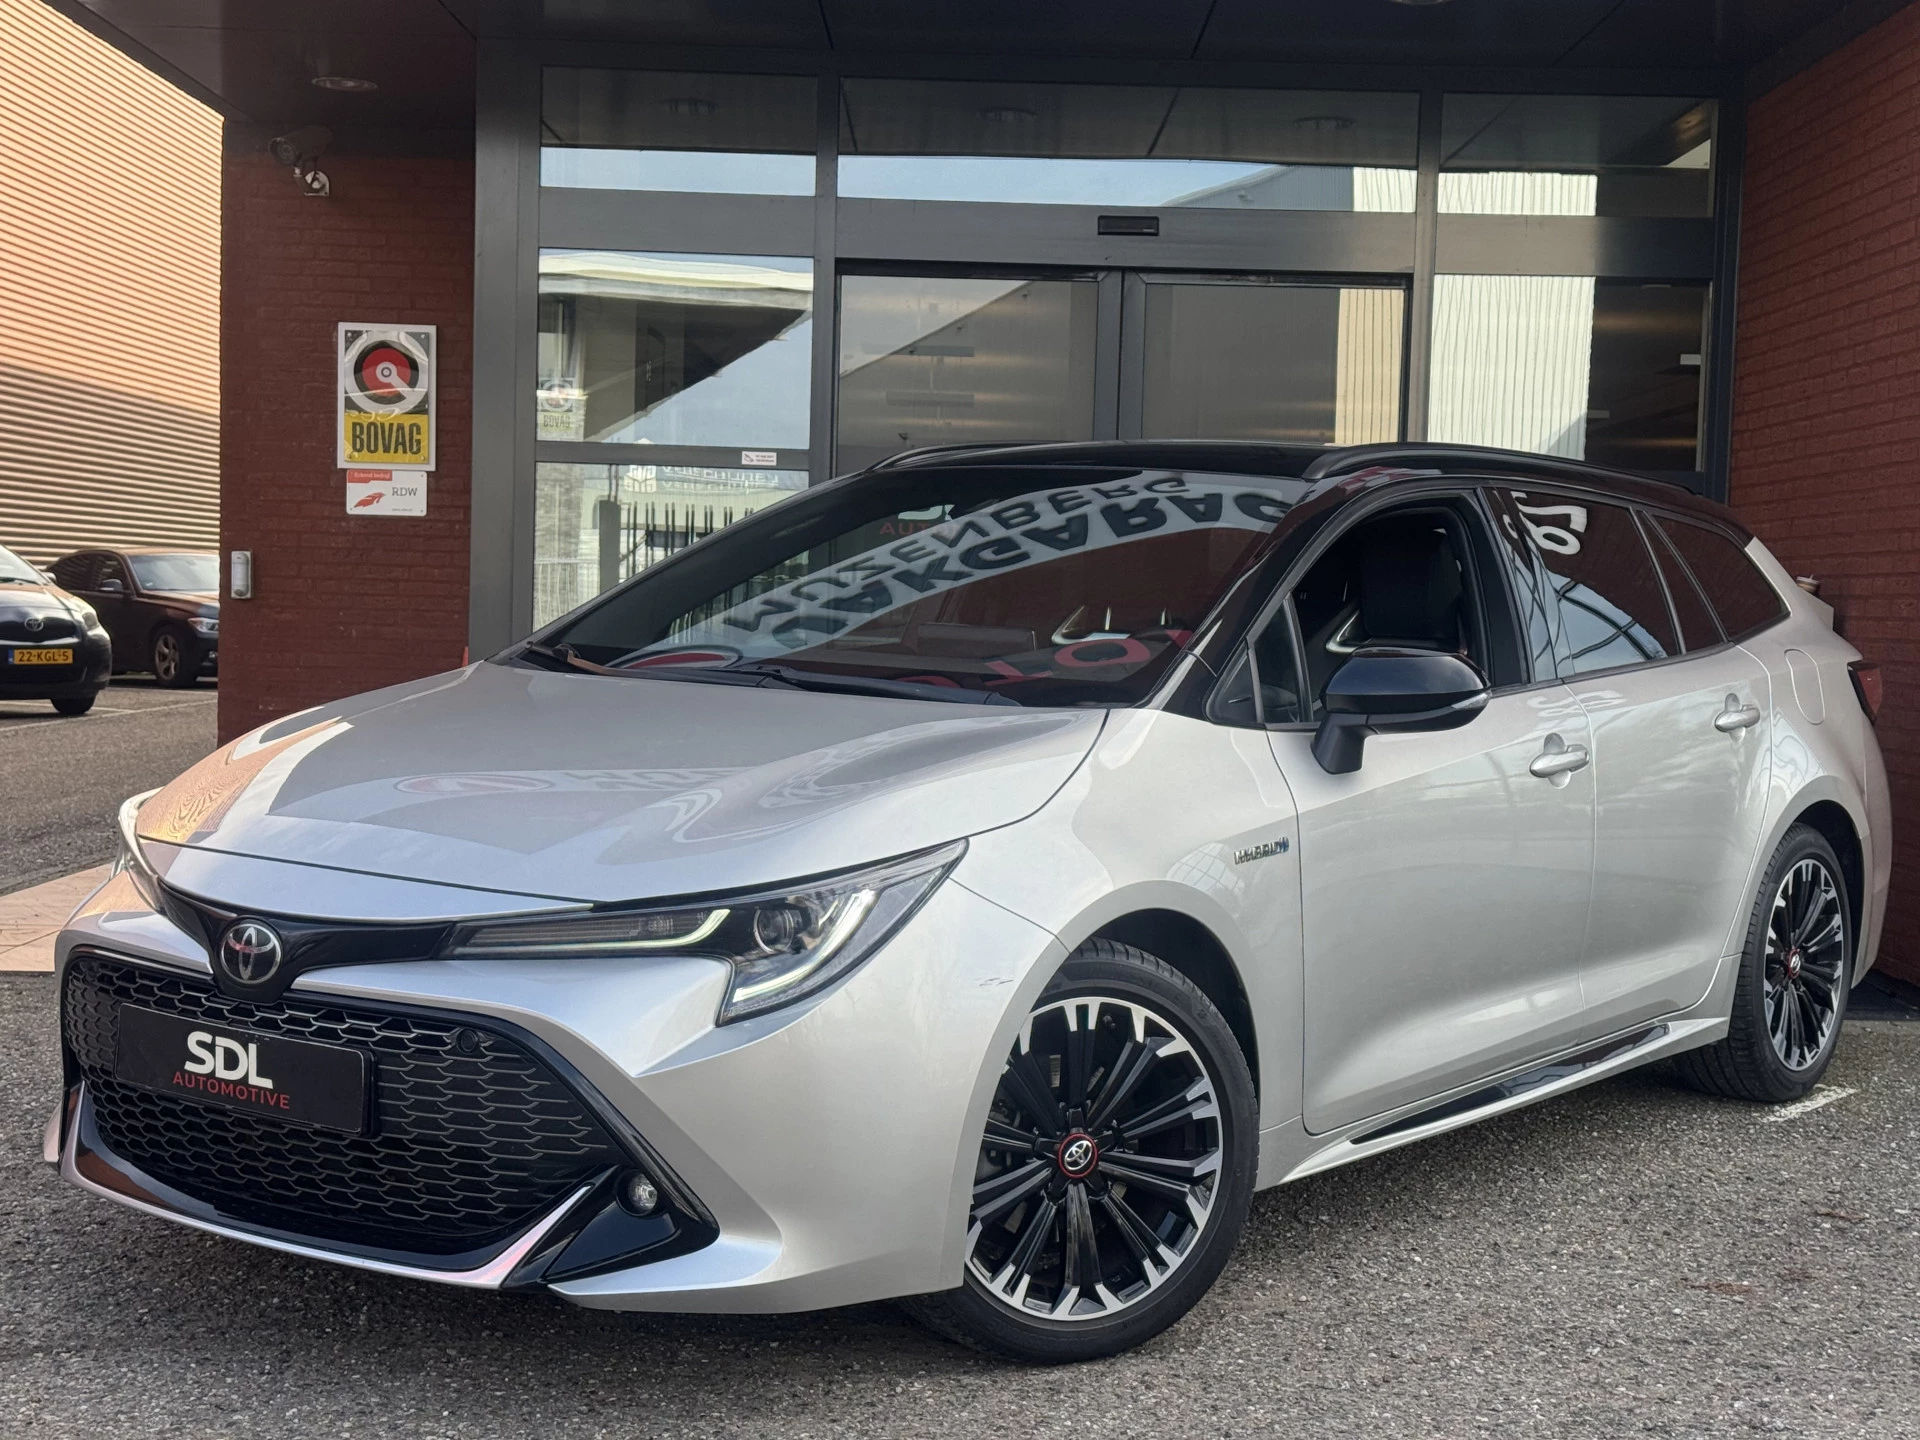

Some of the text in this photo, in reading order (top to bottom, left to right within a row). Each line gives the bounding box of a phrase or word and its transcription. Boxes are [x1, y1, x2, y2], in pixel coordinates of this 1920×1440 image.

[351, 421, 422, 455] BOVAG
[391, 487, 418, 497] RDW
[18, 650, 69, 662] 22-KGL-5
[184, 1031, 274, 1089] SDL
[172, 1070, 290, 1110] AUTOMOTIVE
